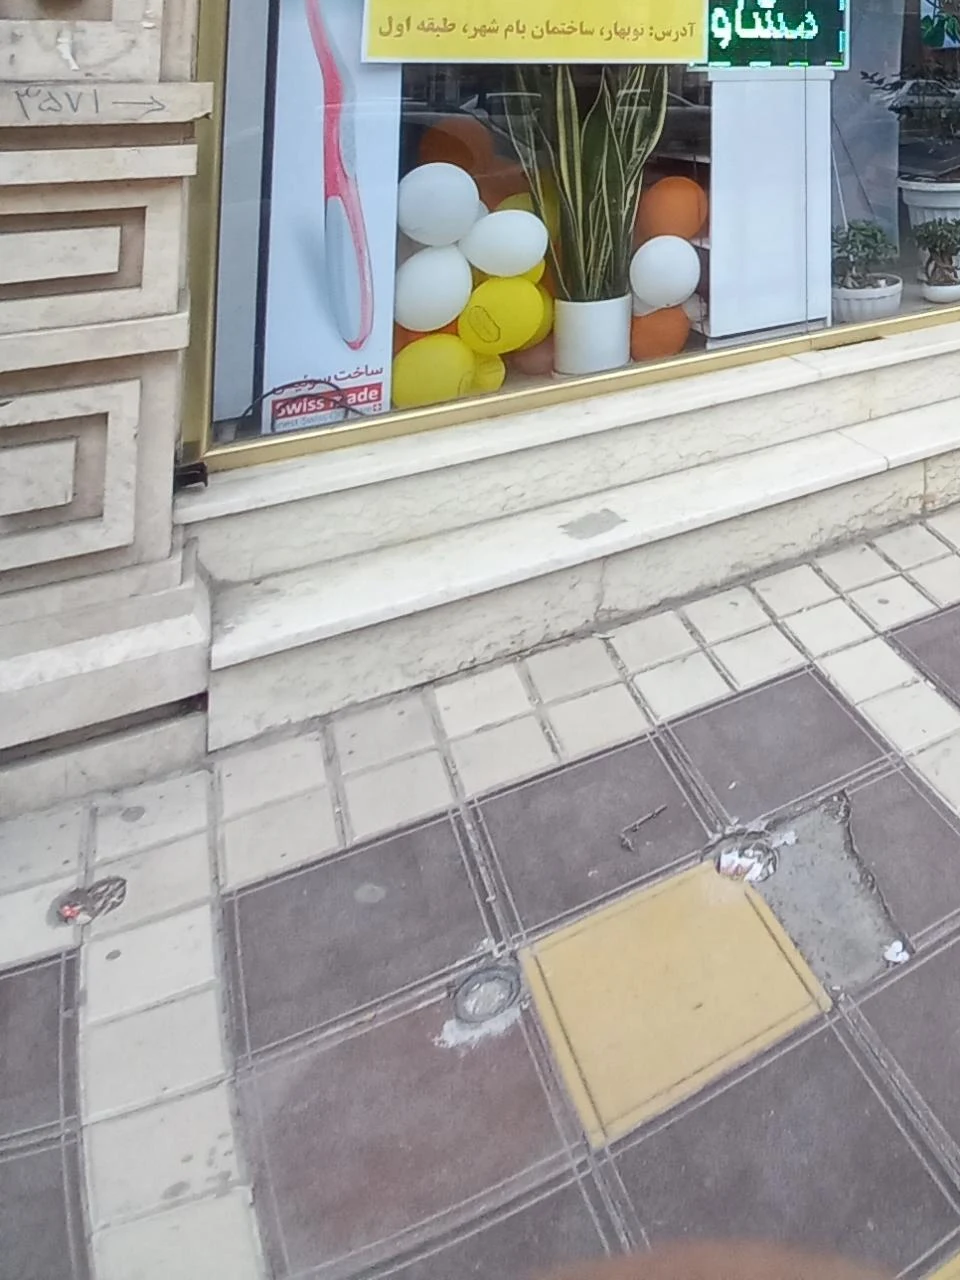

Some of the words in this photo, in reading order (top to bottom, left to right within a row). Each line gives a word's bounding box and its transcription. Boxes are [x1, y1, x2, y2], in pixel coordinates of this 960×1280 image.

[378, 15, 412, 38] اول
[416, 17, 457, 38] طبقه
[462, 18, 500, 39] شهر،
[504, 19, 527, 39] بام
[531, 20, 596, 40] ساختمان
[649, 22, 696, 42] آدرس:
[334, 364, 384, 382] ساخت
